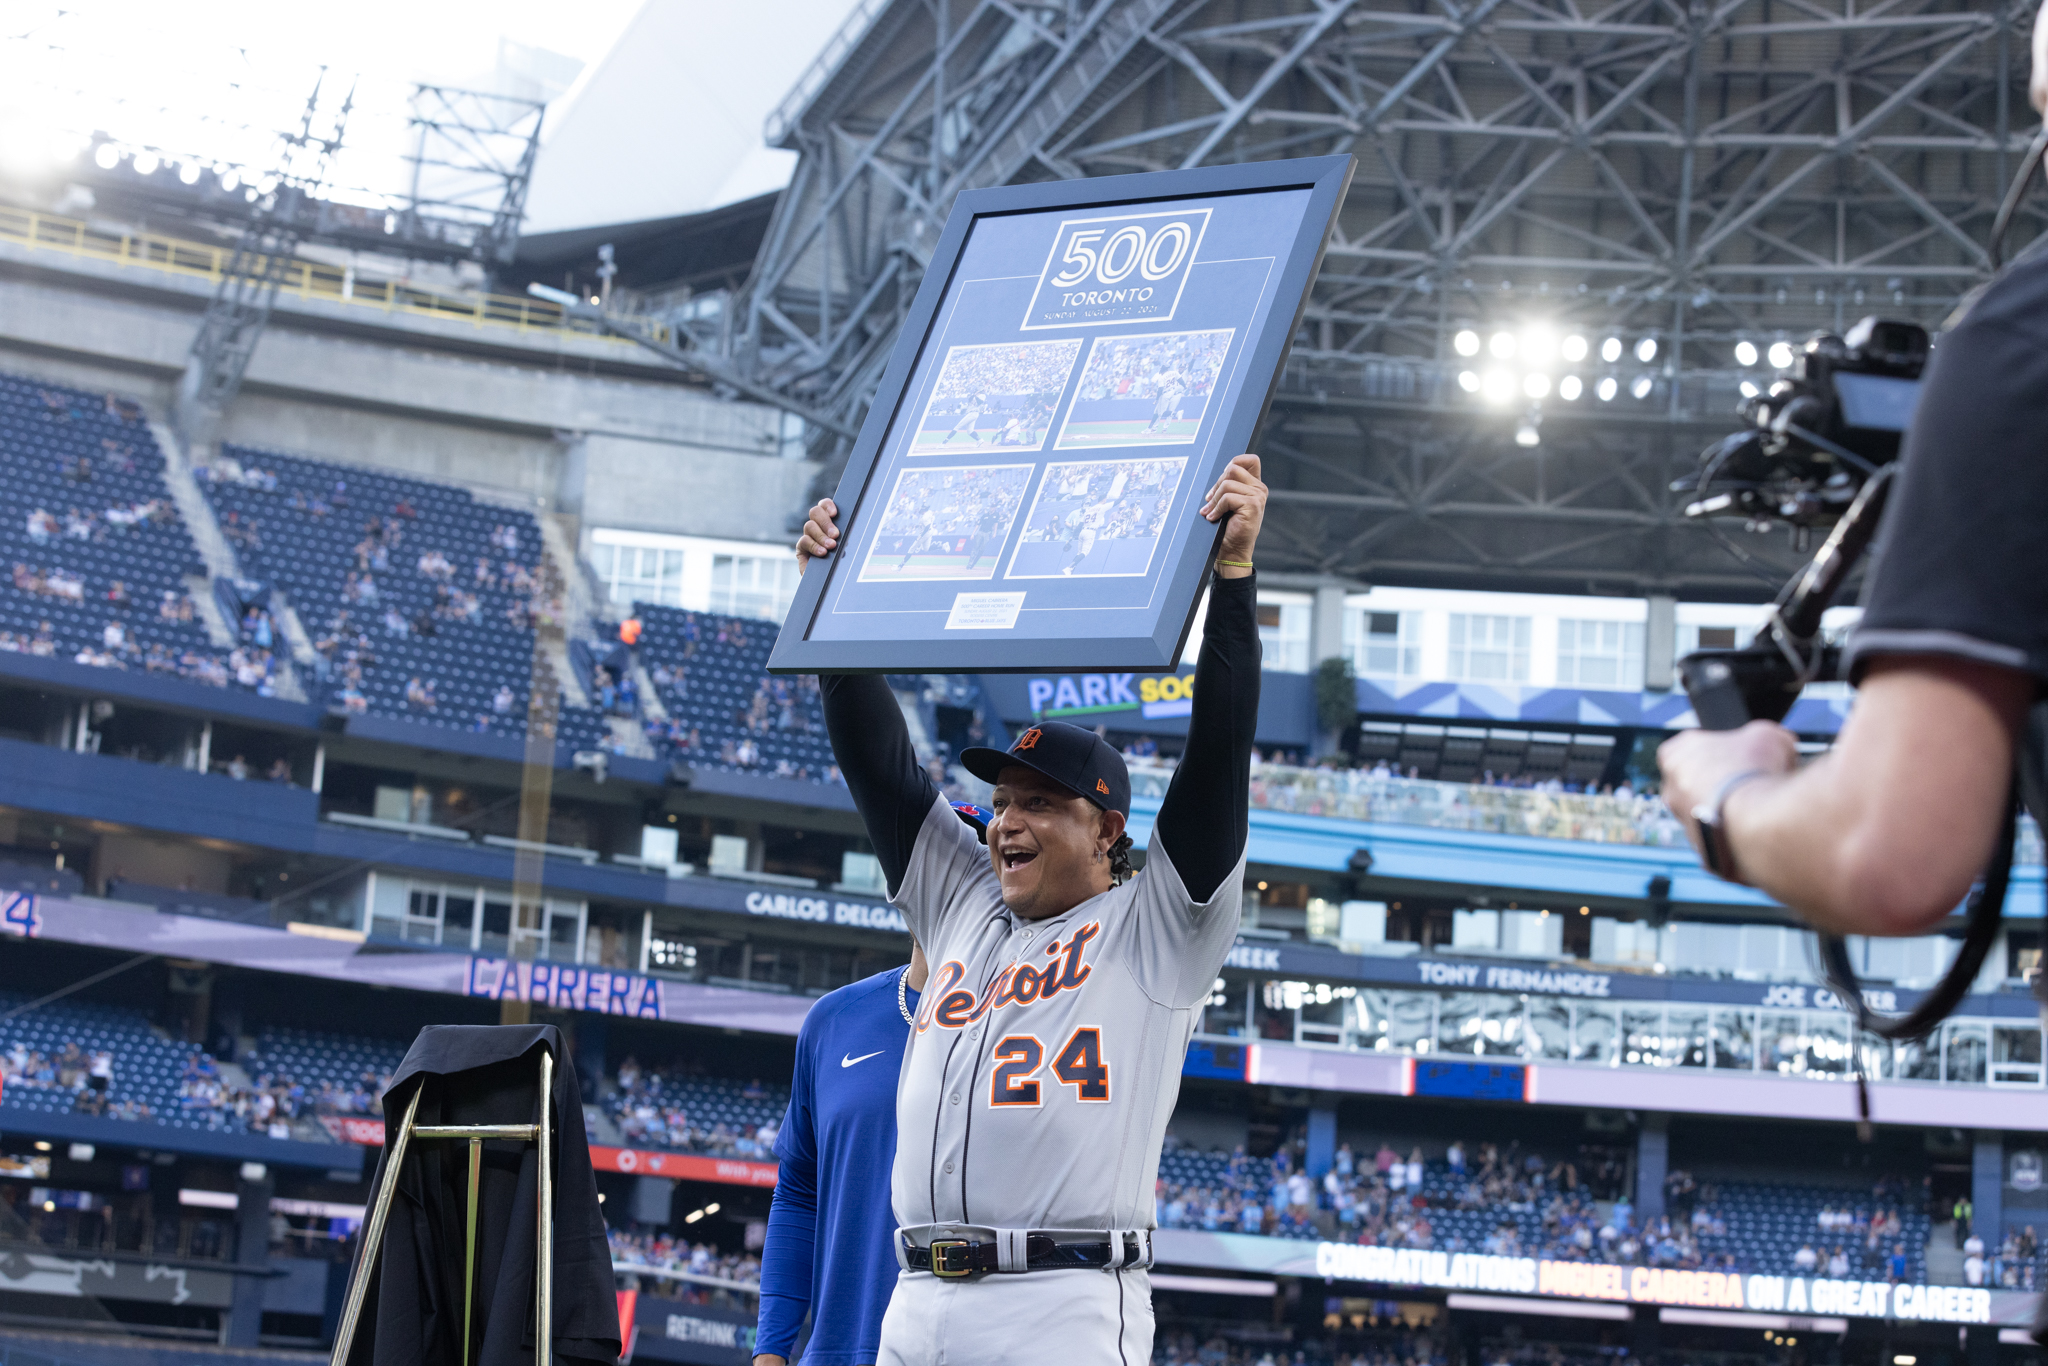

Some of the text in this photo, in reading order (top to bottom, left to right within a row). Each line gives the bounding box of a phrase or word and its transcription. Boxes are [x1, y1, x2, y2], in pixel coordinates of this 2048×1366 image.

[1050, 222, 1191, 288] 500
[1044, 311, 1076, 320] SUNDAY
[1083, 308, 1117, 317] AUGUST
[1062, 287, 1153, 307] TORONTO
[1028, 673, 1138, 713] PARK
[745, 891, 829, 922] CARLOS
[463, 956, 666, 1019] CABRERA
[1418, 961, 1611, 997] TONY FERNANDEZ
[1761, 985, 1897, 1011] JOE CATER
[988, 1025, 1111, 1109] 24
[1316, 1241, 1991, 1324] CONGRATULATIONS MIGUEL CABRERA ON A GREAT CAREER
[665, 1313, 737, 1349] RETHINK
